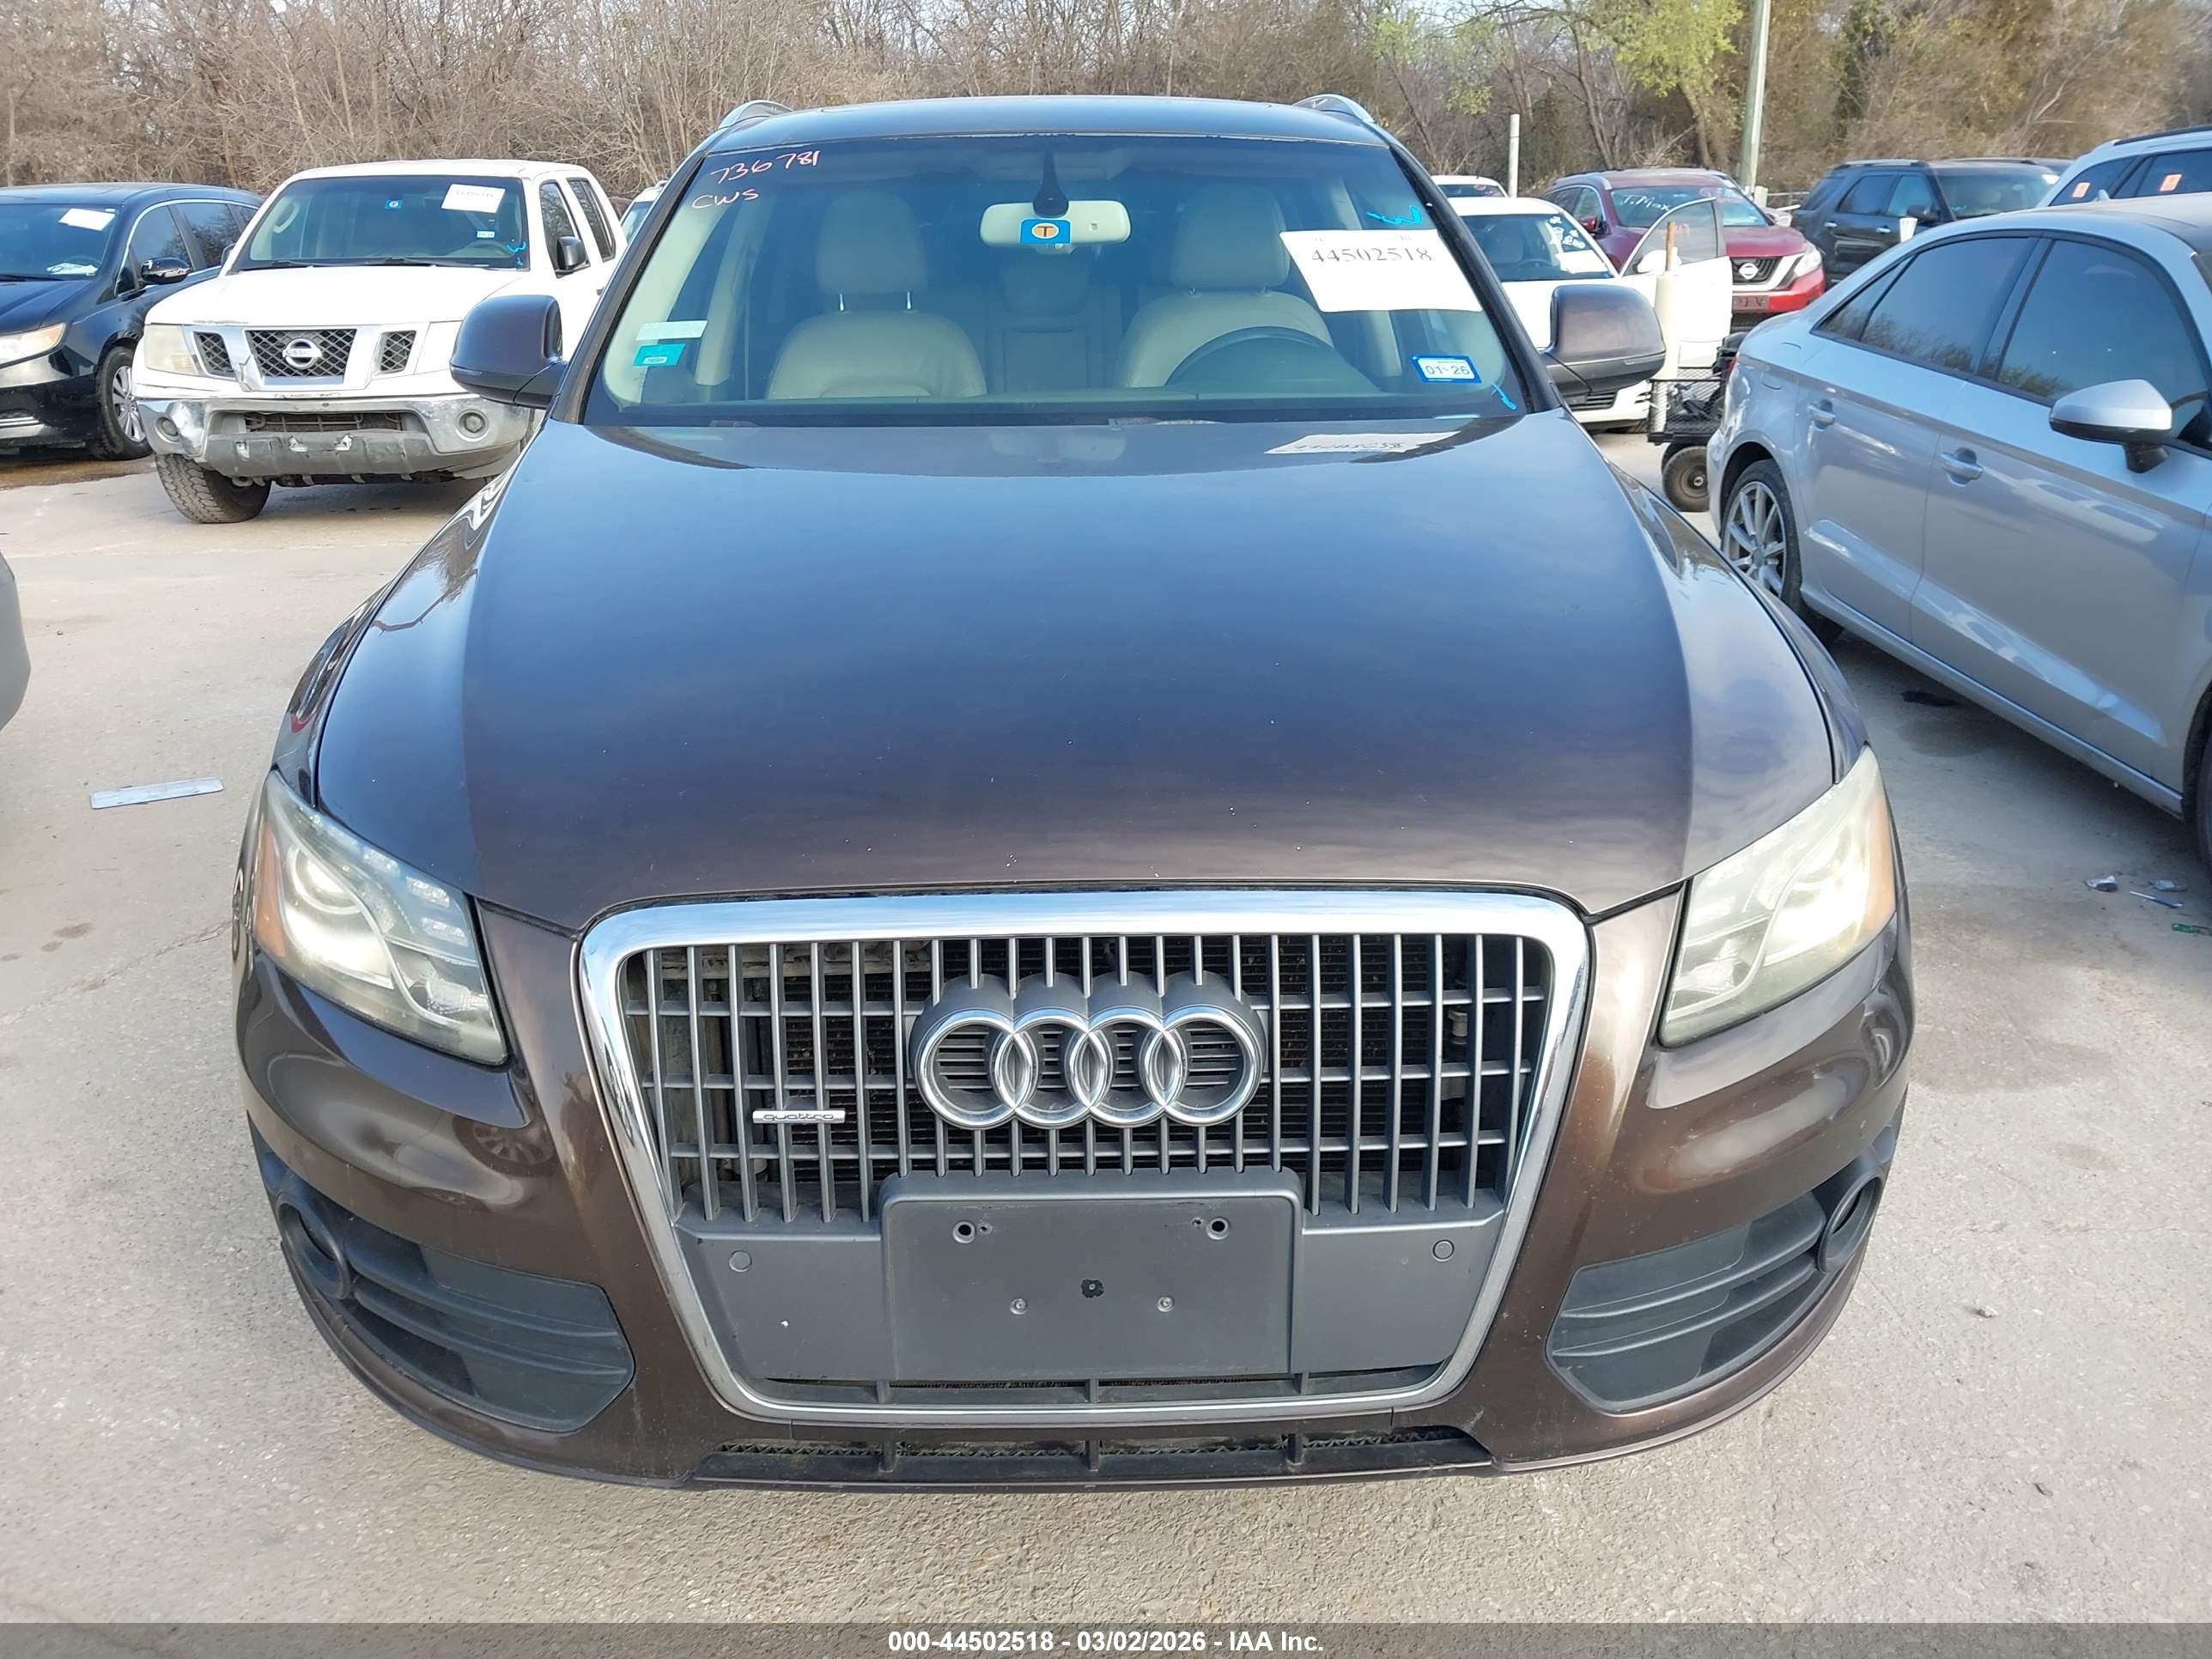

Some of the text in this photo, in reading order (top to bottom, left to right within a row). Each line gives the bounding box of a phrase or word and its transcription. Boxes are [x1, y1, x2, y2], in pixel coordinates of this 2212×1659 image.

[691, 188, 759, 209] CWS
[1311, 246, 1433, 263] 44502518
[763, 1112, 835, 1121] quattro
